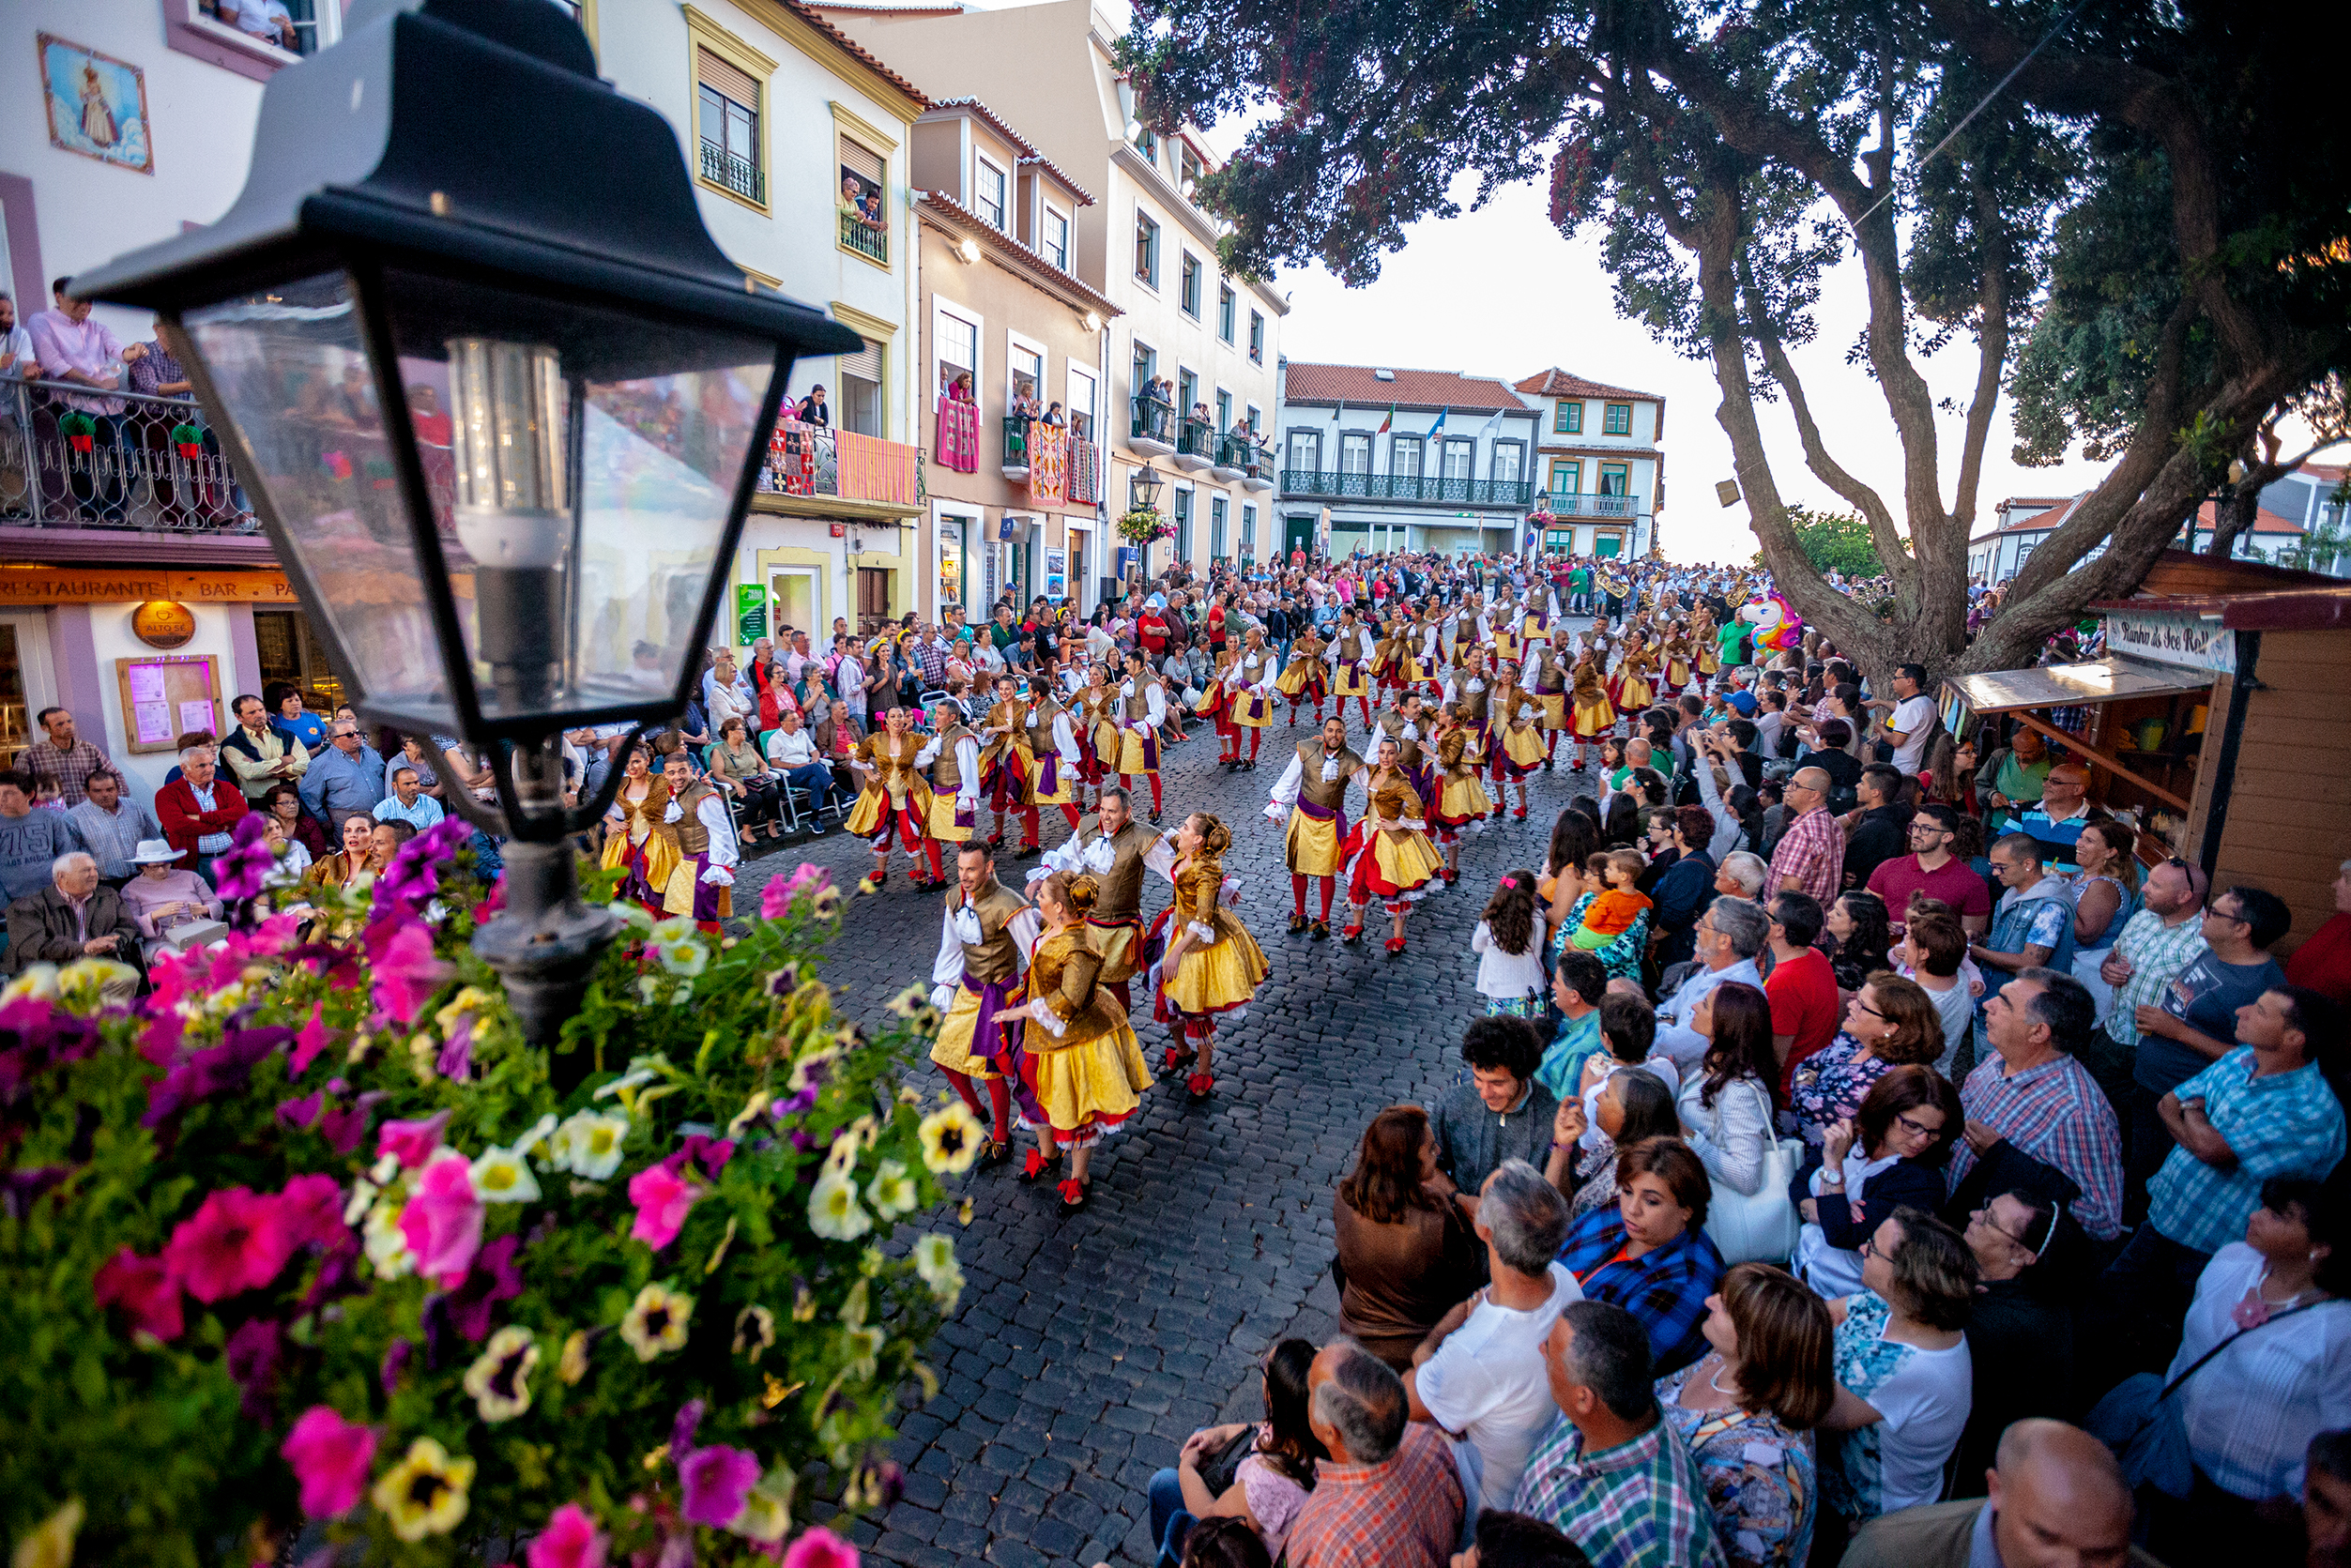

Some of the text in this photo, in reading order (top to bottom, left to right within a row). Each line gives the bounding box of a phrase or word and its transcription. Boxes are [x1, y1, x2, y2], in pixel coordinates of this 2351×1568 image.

[200, 583, 237, 597] BAR
[275, 583, 298, 597] PA
[145, 624, 172, 632] ALTO
[2163, 626, 2182, 651] Ice
[2183, 627, 2209, 655] Roll
